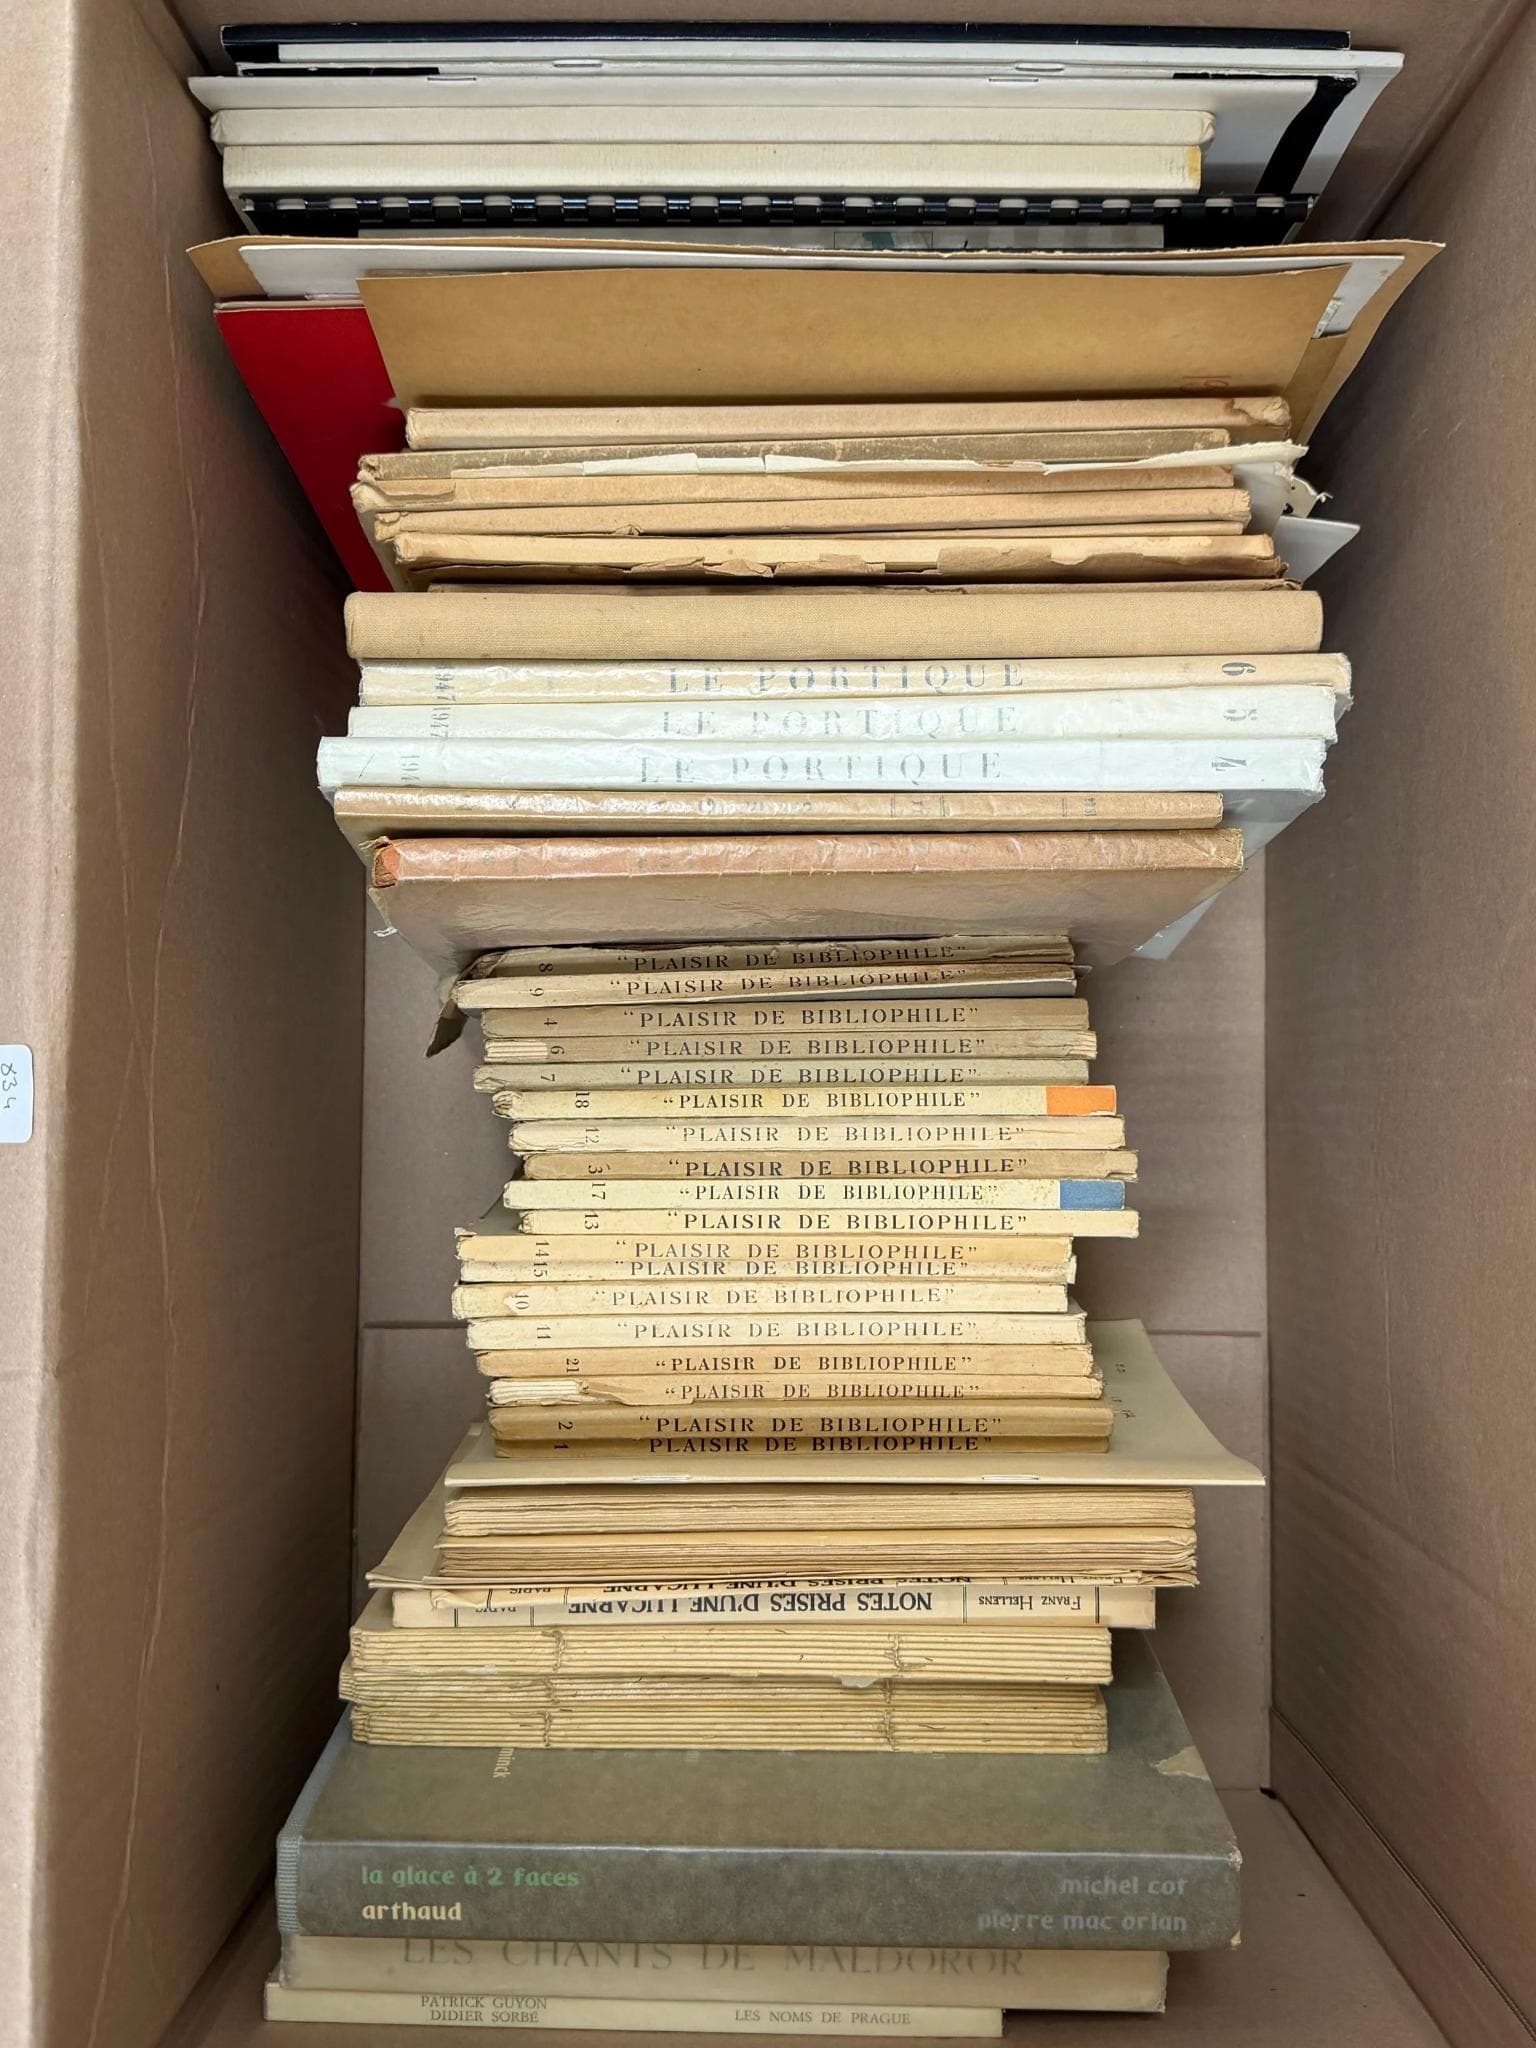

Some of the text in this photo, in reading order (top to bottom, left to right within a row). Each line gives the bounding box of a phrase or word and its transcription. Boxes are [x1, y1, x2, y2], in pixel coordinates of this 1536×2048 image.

[1221, 662, 1256, 676] 6
[668, 663, 1023, 694] LE PORTIQUE
[430, 706, 451, 739] 1947
[663, 706, 1017, 739] LE PORTIQUE
[1222, 708, 1258, 721] 5
[400, 755, 420, 787] 194
[640, 752, 1000, 785] LE PORTIQUE
[538, 962, 554, 973] 8
[618, 946, 966, 971] “PLAISIR DE BIBLIOPHILE”
[610, 969, 966, 996] “PLAISIR DE BIBLIOPHILE”
[543, 1017, 559, 1027] 4
[623, 1007, 979, 1028] “PLAISIR DE BIBLIOPHILE”
[630, 1038, 985, 1056] “PLAISIR DE BIBLIOPHILE”
[540, 1073, 556, 1082] 7
[621, 1067, 977, 1085] “PLAISIR DE BIBLIOPHILE”
[575, 1091, 590, 1109] 18
[663, 1092, 980, 1109] “PLAISIR DE BIBLIOPHILE”
[585, 1126, 600, 1144] 12
[666, 1126, 1024, 1142] “PLAISIR DE BIBLIOPHILE”
[588, 1164, 603, 1176] 3
[669, 1158, 1027, 1177] “PLAISIR DE BIBLIOPHILE”
[591, 1182, 606, 1201] 17
[680, 1184, 998, 1201] “PLAISIR DE BIBLIOPHILE”
[584, 1212, 600, 1230] 13
[667, 1211, 1027, 1230] “PLAISIR DE BIBLIOPHILE”
[535, 1240, 550, 1257] 14
[616, 1240, 977, 1260] “PLAISIR DE BIBLIOPHILE”
[533, 1261, 548, 1278] 15
[615, 1261, 968, 1276] “PLAISIR DE BIBLIOPHILE”
[514, 1293, 529, 1310] 10
[596, 1288, 953, 1306] “PLAISIR DE BIBLIOPHILE”
[536, 1325, 551, 1340] 11
[617, 1321, 977, 1339] “PLAISIR DE BIBLIOPHILE”
[566, 1358, 580, 1373] 21
[655, 1356, 972, 1372] “PLAISIR DE BIBLIOPHILE”
[665, 1384, 980, 1400] “PLAISIR DE BIBLIOPHILE”
[557, 1421, 573, 1430] 2
[639, 1415, 1001, 1433] “PLAISIR DE BIBLIOPHILE”
[765, 1437, 796, 1452] DE
[812, 1436, 992, 1452] BIBLIOPHILE”
[770, 1592, 846, 1612] PRISES
[857, 1592, 933, 1611] NOTES
[361, 1865, 581, 1888] la glace à 2 faces
[1060, 1876, 1189, 1896] michel cot
[361, 1901, 462, 1921] arthaud
[976, 1910, 1054, 1932] pierre
[1063, 1914, 1113, 1930] mac
[403, 1938, 1024, 1976] LES CHANTS DE MALDOROR
[420, 1995, 548, 2009] PATRICK GUYON
[430, 2009, 539, 2023] DIDIER SORBÉ
[734, 2009, 911, 2025] LES NOMS DE PRAGUE
